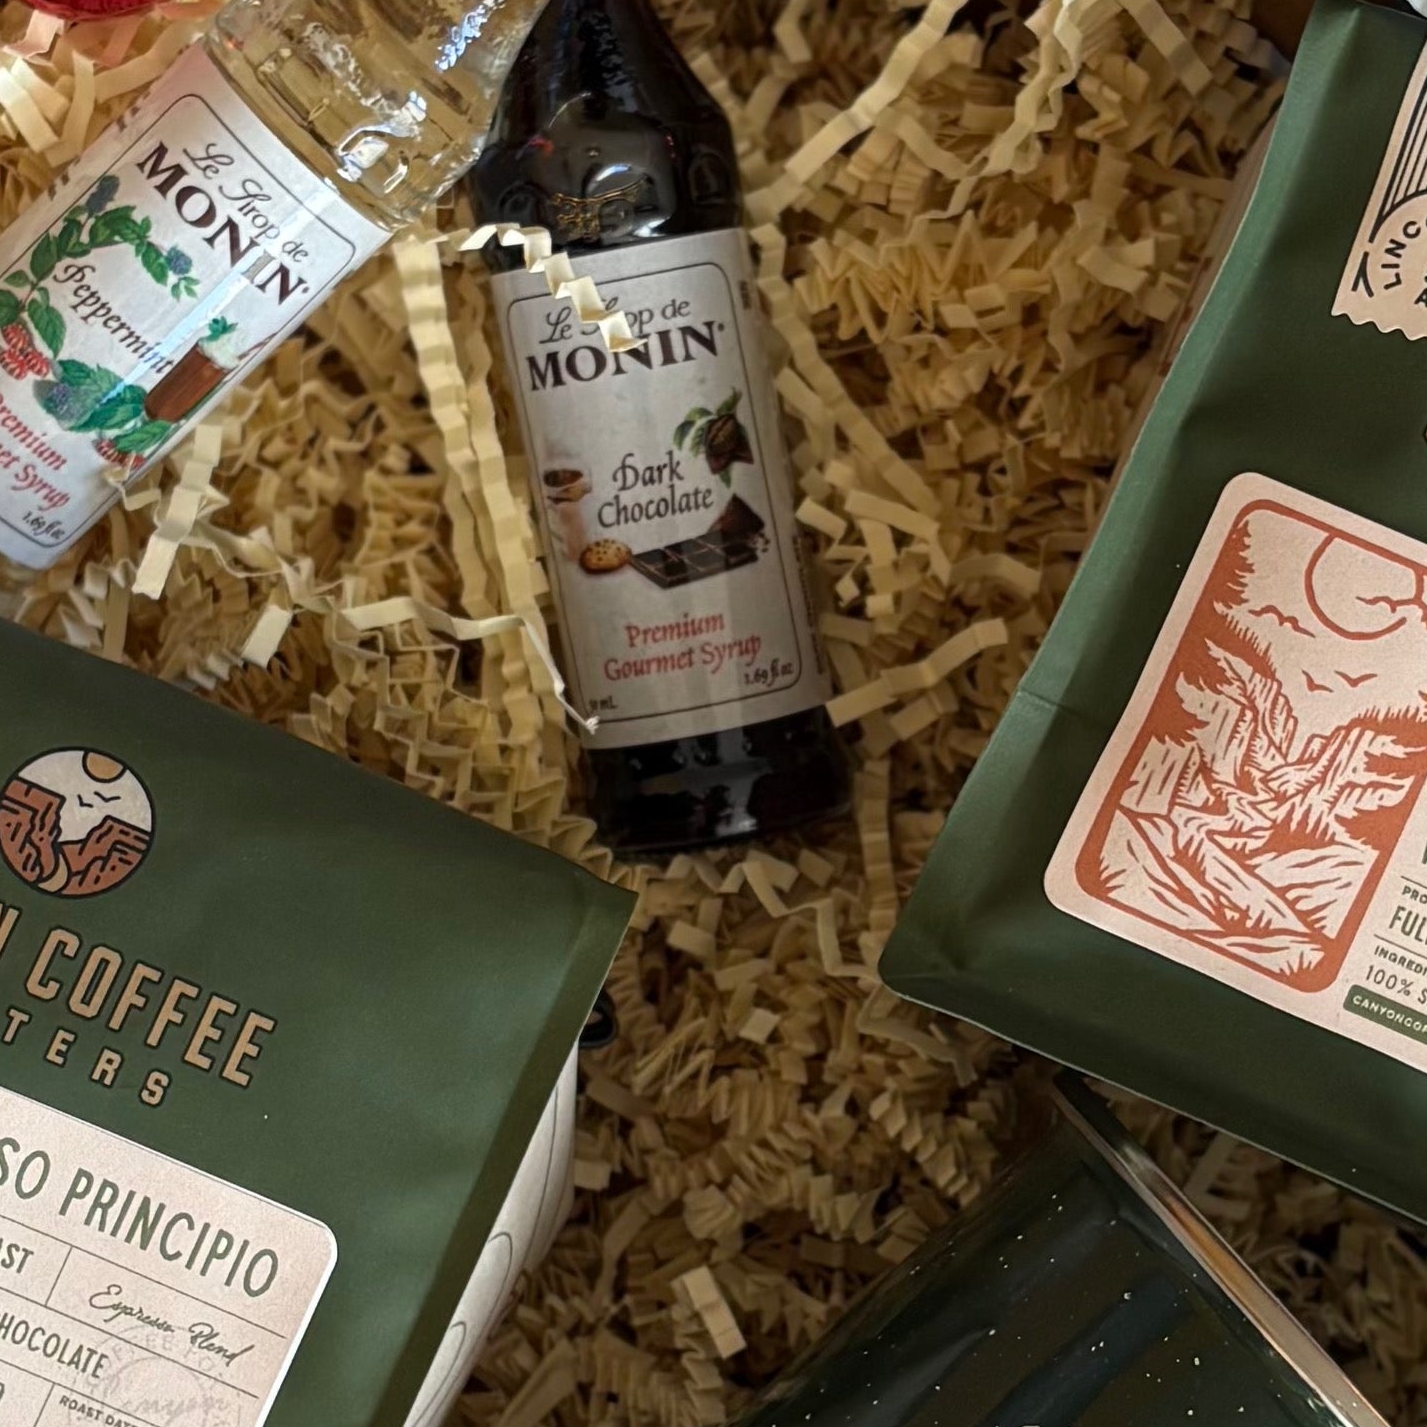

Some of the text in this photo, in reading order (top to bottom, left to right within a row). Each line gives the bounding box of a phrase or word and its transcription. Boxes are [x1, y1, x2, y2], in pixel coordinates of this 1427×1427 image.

[134, 141, 306, 306] MONIN
[183, 143, 310, 263] Le Sirop de
[54, 257, 173, 376] Peppermint
[539, 305, 572, 345] Le
[661, 299, 691, 321] de
[526, 320, 720, 392] MONIN
[11, 463, 70, 511] Syrup
[612, 451, 684, 492] Dark
[598, 485, 714, 529] Chocolate
[625, 612, 725, 649] Premium
[603, 634, 762, 682] Gourmet Syrup
[1365, 965, 1414, 997] 100%
[24, 927, 277, 1087] COFFEE
[59, 1167, 279, 1298] PRINCIPIO
[88, 1283, 255, 1367] Espresso Blend
[59, 1394, 103, 1422] ROAST
